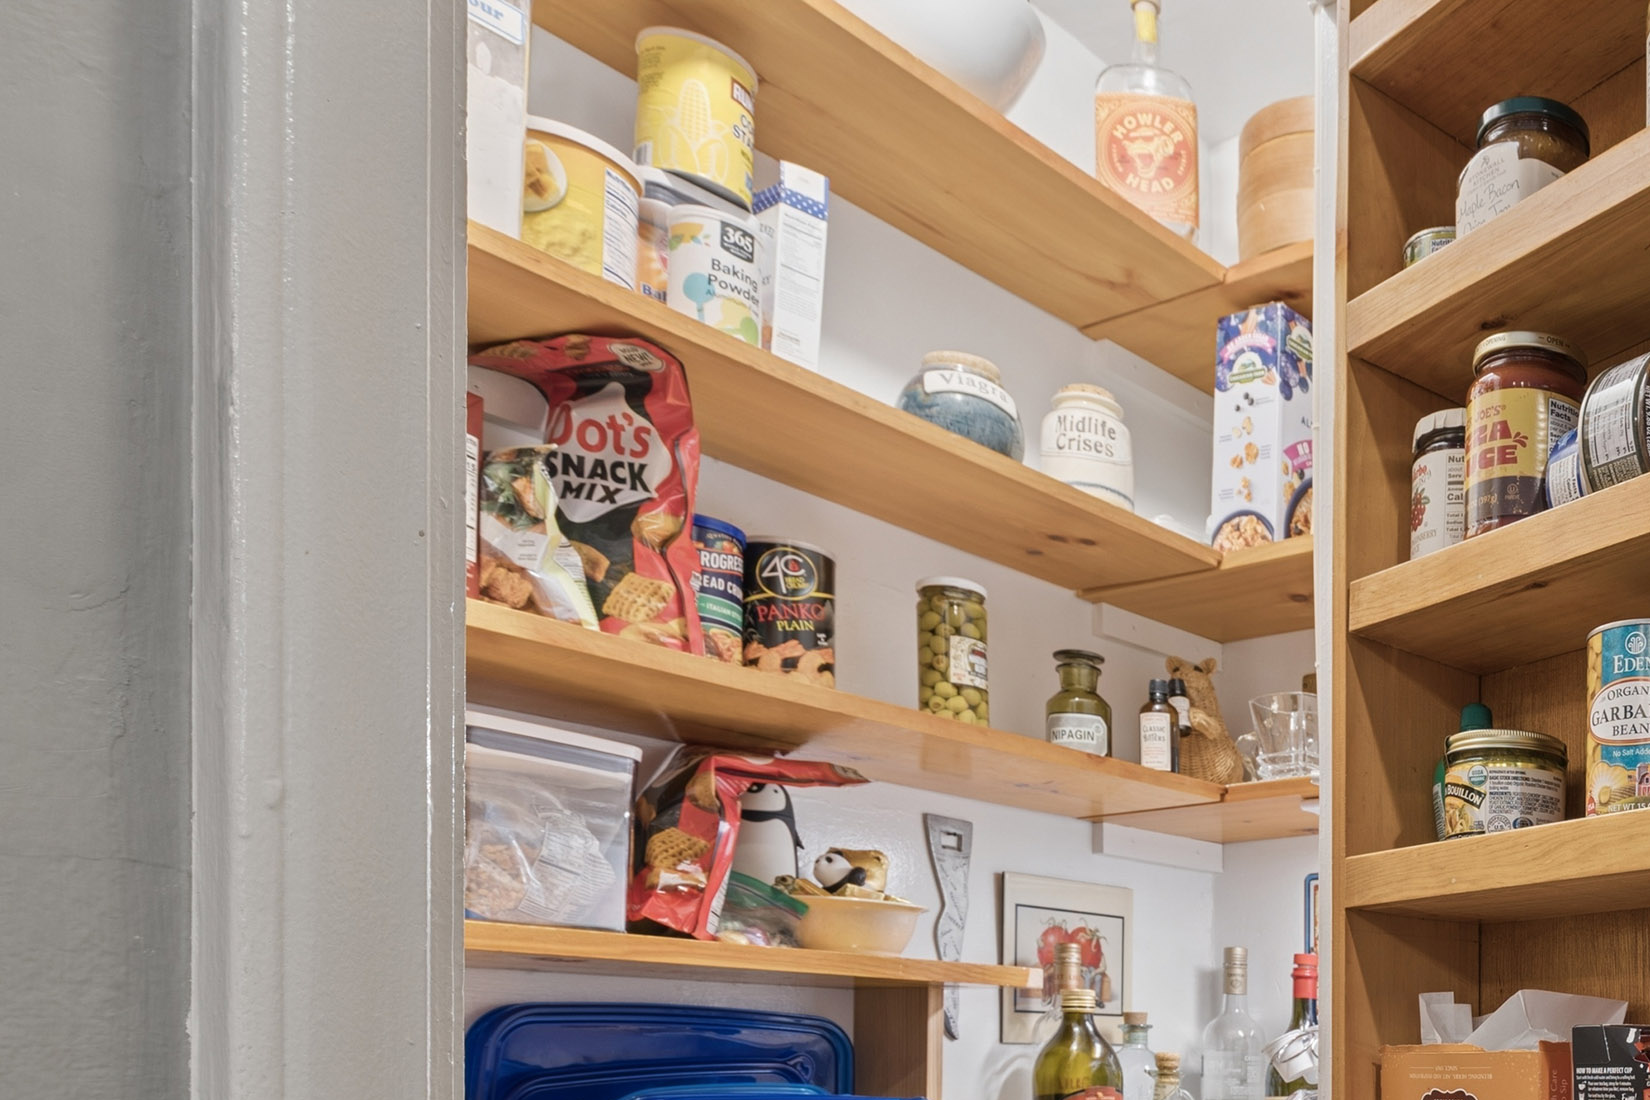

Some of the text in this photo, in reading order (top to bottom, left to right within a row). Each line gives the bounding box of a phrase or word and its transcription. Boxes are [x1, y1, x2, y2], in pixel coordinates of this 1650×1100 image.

[1112, 113, 1184, 145] HOWLER
[1125, 173, 1174, 194] HEAD
[1484, 179, 1520, 204] Bacon
[722, 226, 754, 253] 365
[712, 258, 758, 293] Baking
[708, 274, 760, 307] Powder
[1546, 337, 1564, 347] OPEN
[939, 372, 1008, 403] Viagra
[1056, 414, 1117, 441] Midlife
[1550, 410, 1571, 422] Facts
[1056, 433, 1115, 458] Crises
[544, 450, 651, 493] SNACK
[560, 480, 623, 504] MIX
[761, 554, 806, 594] 4C
[757, 603, 826, 622] PANKO
[776, 620, 816, 632] PLAIN
[1051, 727, 1095, 744] NIPAGIN
[1612, 750, 1621, 758] No
[1622, 749, 1634, 757] Salt
[1447, 784, 1483, 807] BOUILLON
[1550, 1069, 1558, 1092] Care
[1560, 1079, 1568, 1094] Sip
